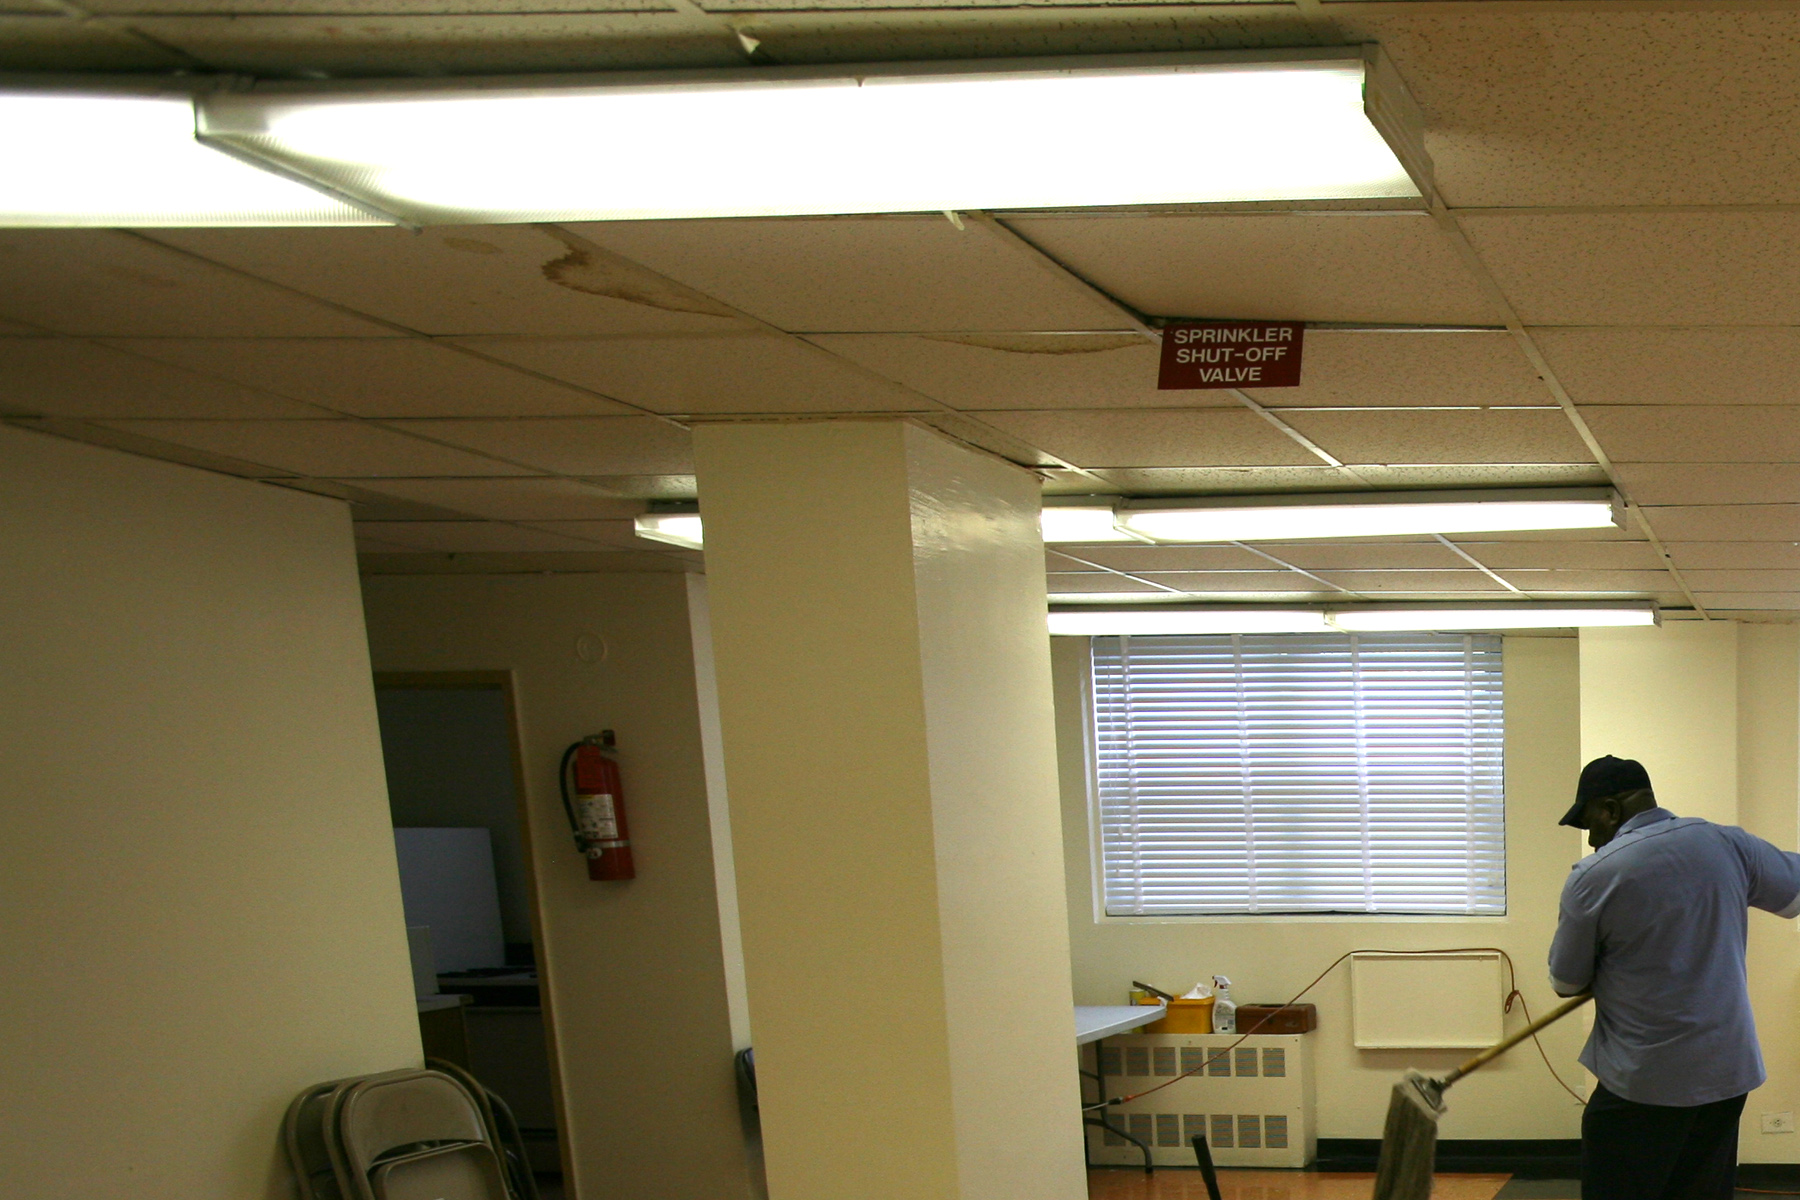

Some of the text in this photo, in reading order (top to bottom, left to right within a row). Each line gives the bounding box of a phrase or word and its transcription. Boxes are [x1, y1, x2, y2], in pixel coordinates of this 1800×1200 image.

[1174, 327, 1293, 344] SPRINKLER
[1176, 347, 1288, 364] SHUT-OFF
[1199, 367, 1262, 383] VALVE
